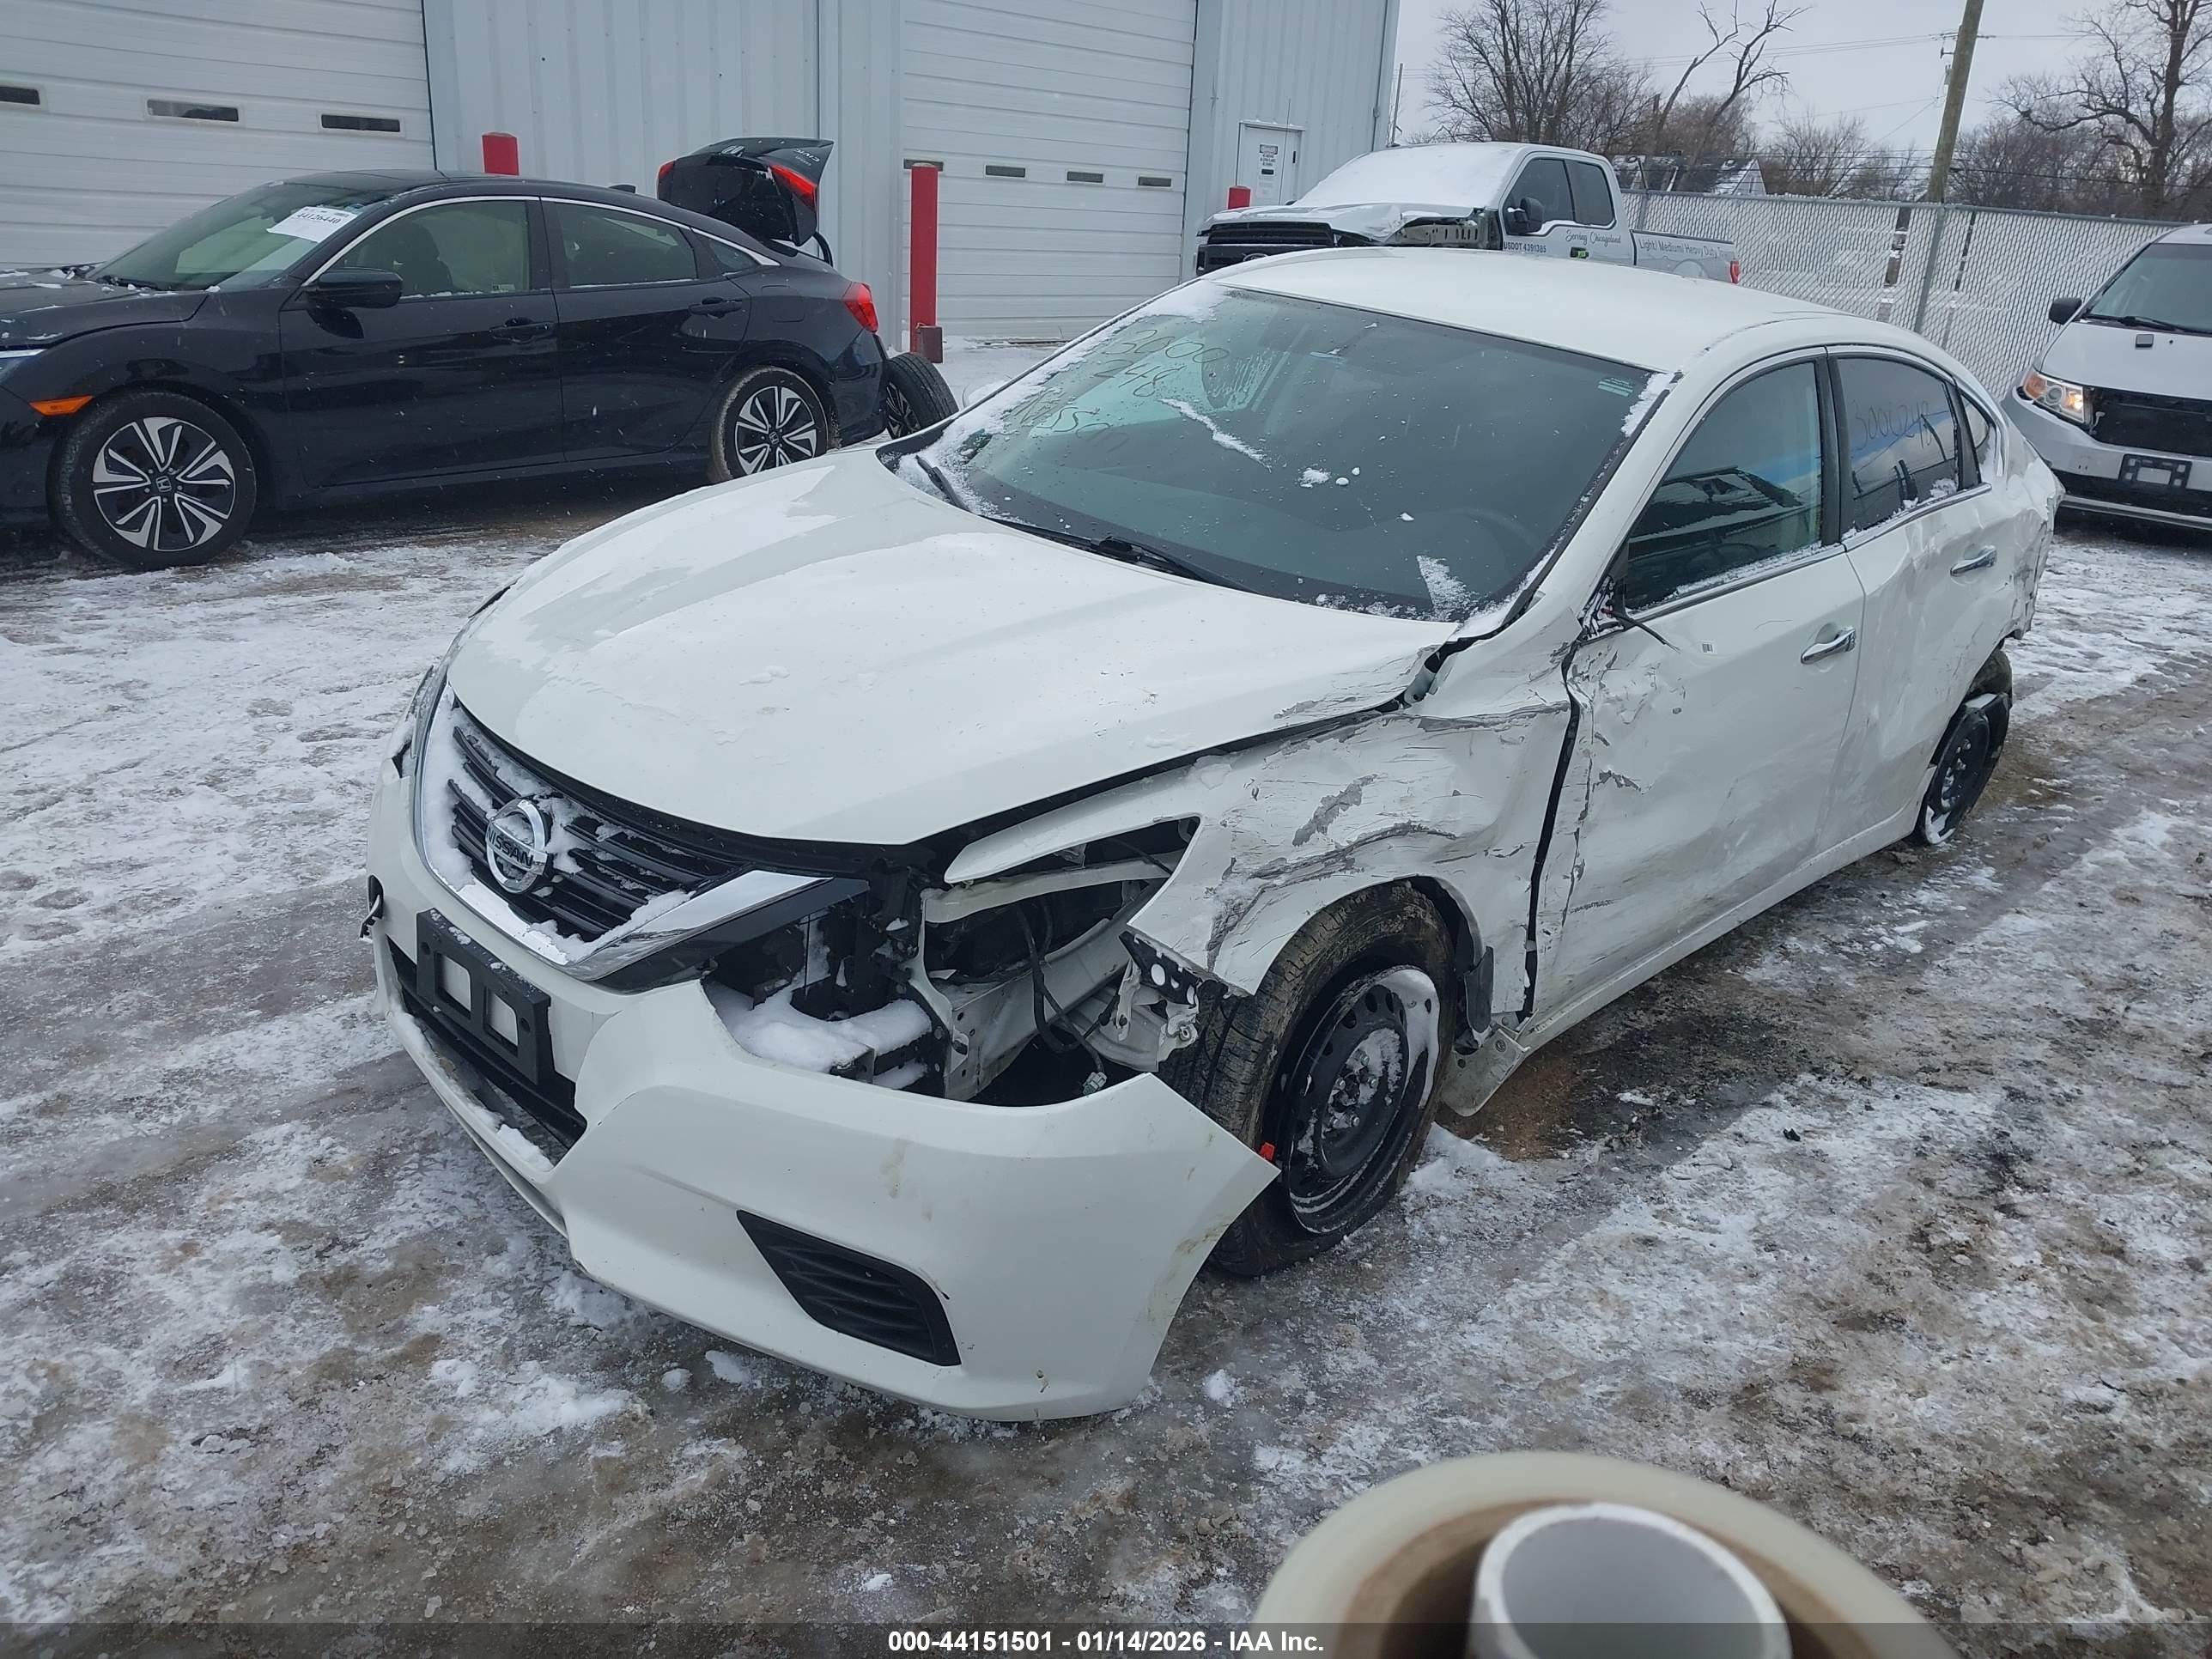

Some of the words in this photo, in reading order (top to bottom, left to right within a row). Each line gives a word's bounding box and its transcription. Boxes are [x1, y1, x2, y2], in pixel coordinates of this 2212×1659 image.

[793, 149, 820, 161] CIVIC
[1503, 241, 1522, 250] USDOT
[1102, 329, 1231, 364] 3000
[1093, 359, 1187, 398] 248
[486, 825, 534, 866] NISSAN
